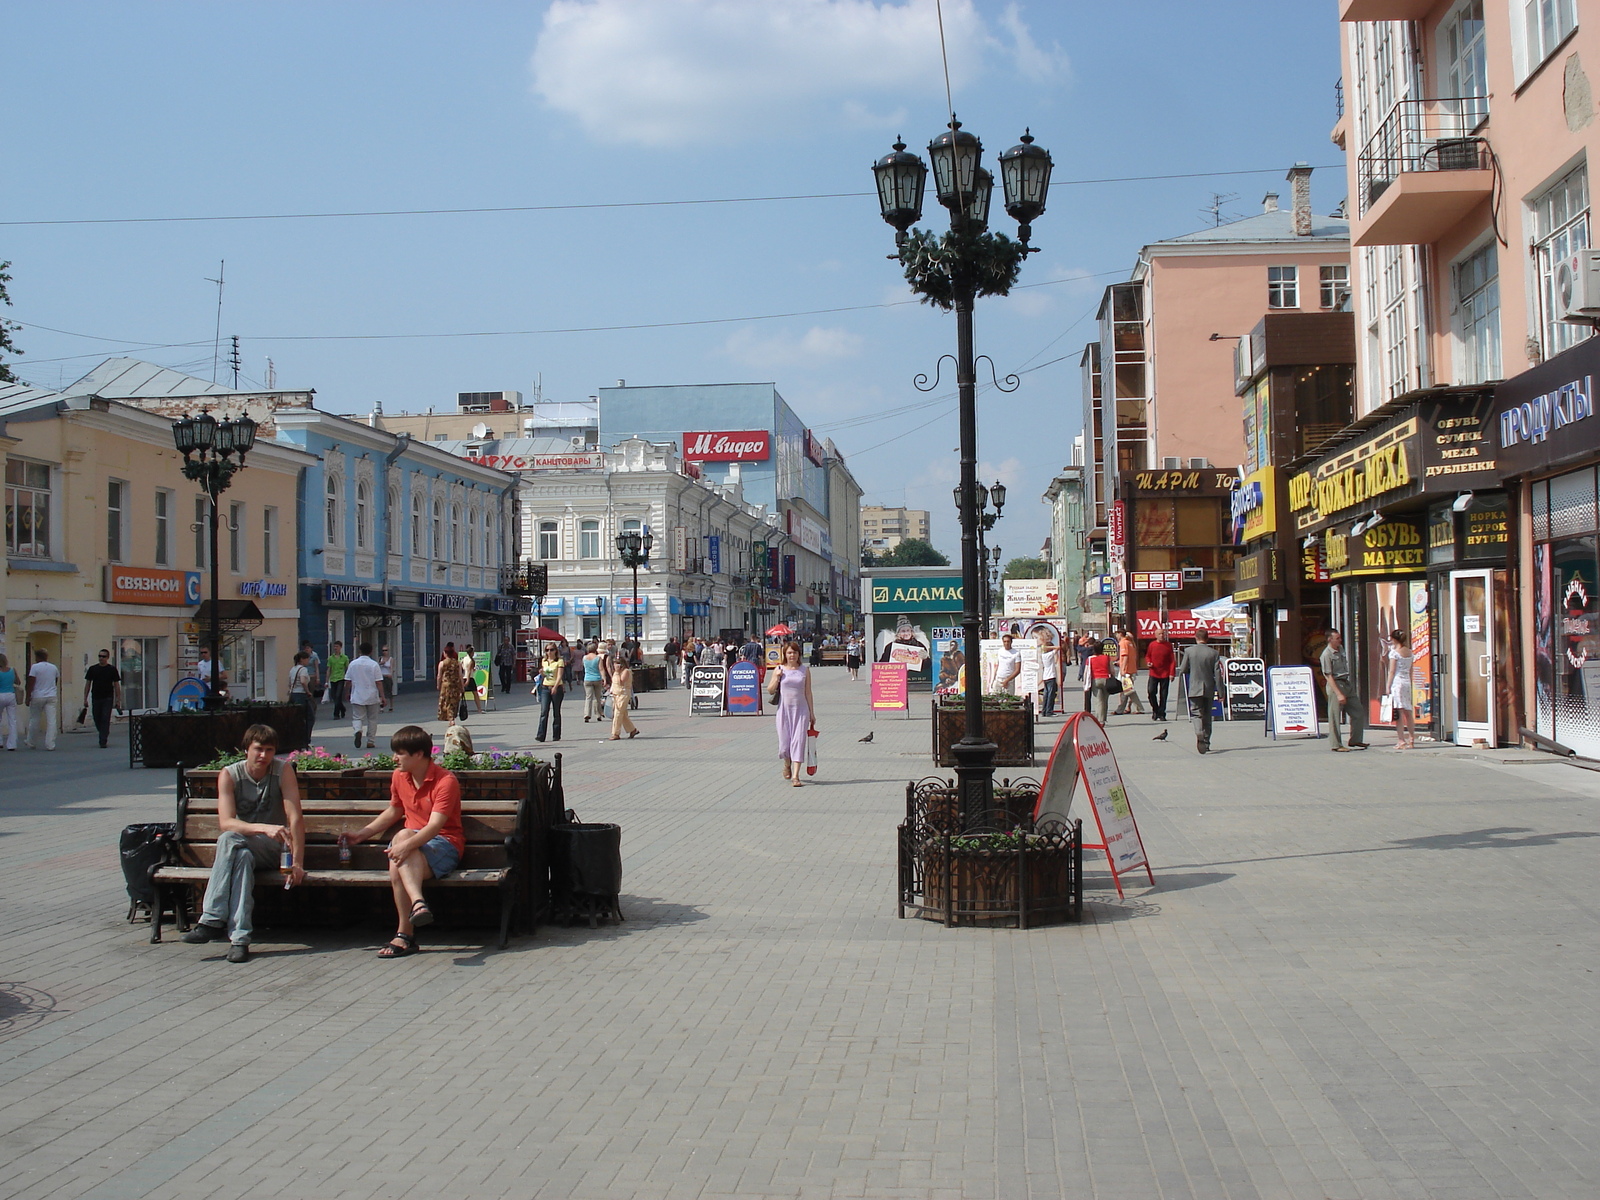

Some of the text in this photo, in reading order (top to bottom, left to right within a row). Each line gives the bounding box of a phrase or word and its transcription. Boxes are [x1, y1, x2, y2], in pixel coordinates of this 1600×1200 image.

[1501, 375, 1593, 448] ПРОДУКТЫ
[1437, 417, 1480, 429] ОБУВЬ
[1436, 430, 1483, 444] СУМКИ
[688, 434, 764, 458] М.видео
[1441, 447, 1479, 460] МЕХА
[536, 457, 591, 466] КАНЦТОВАРЫ
[1425, 460, 1496, 477] ДУБЛЕНКИ
[1135, 471, 1200, 490] ШАРМ
[1288, 471, 1311, 513] МИР
[1318, 467, 1356, 516] КОЖИ
[1364, 441, 1411, 499] МЕХА
[1470, 510, 1507, 522] НОРКА
[1364, 523, 1420, 548] ОБУВЬ
[1470, 522, 1507, 533] СУРОК
[1302, 546, 1316, 580] ЗАЙД
[1362, 549, 1423, 567] МАРКЕТ
[116, 576, 179, 591] СВЯЗНОЙ
[330, 585, 369, 602] БУКИНИСТ
[423, 592, 443, 607] ЦЕНТР
[497, 599, 514, 611] ЦЕНТР
[441, 620, 469, 638] СКИДКА
